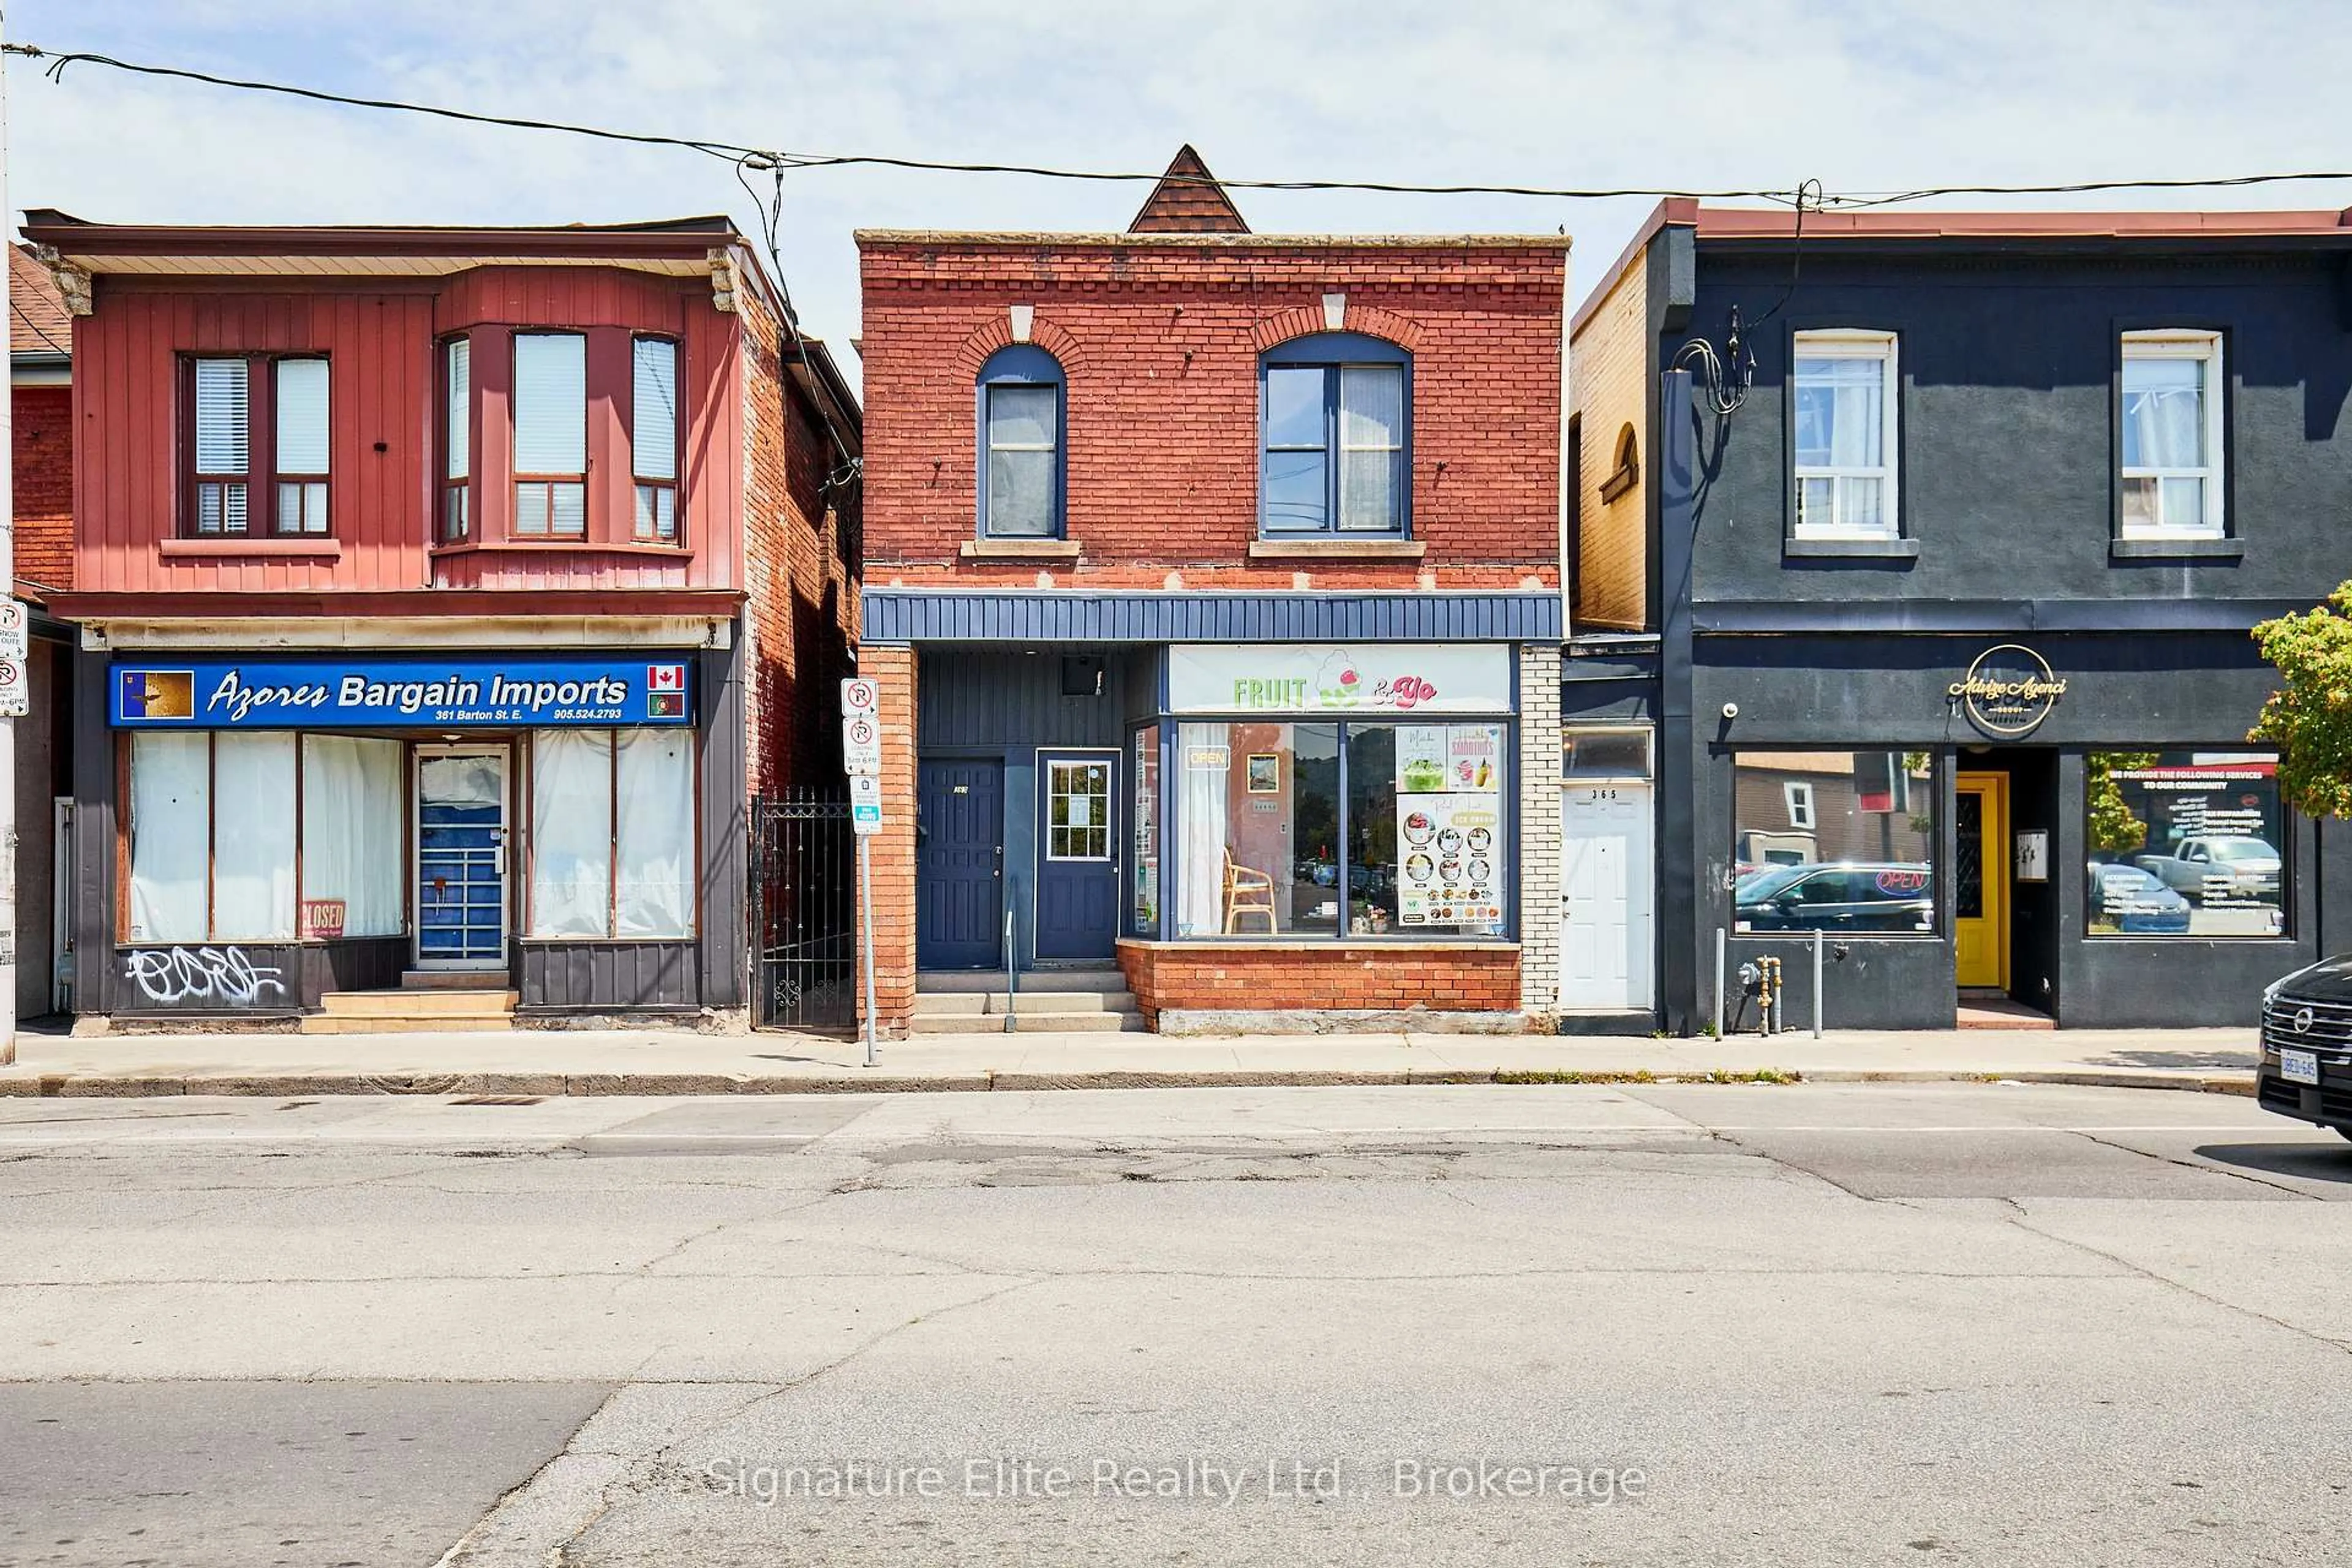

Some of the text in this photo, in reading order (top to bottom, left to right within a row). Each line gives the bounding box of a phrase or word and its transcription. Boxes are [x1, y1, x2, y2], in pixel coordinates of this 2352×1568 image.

[207, 669, 626, 722] Azores Bargain Imports
[1234, 678, 1306, 707] FRUIT
[435, 710, 522, 720] 361 Barton St. E.
[553, 709, 622, 719] 905.524.2793
[1190, 752, 1225, 764] OPEN
[1593, 790, 1615, 799] 365
[1879, 871, 1924, 888] OPEN
